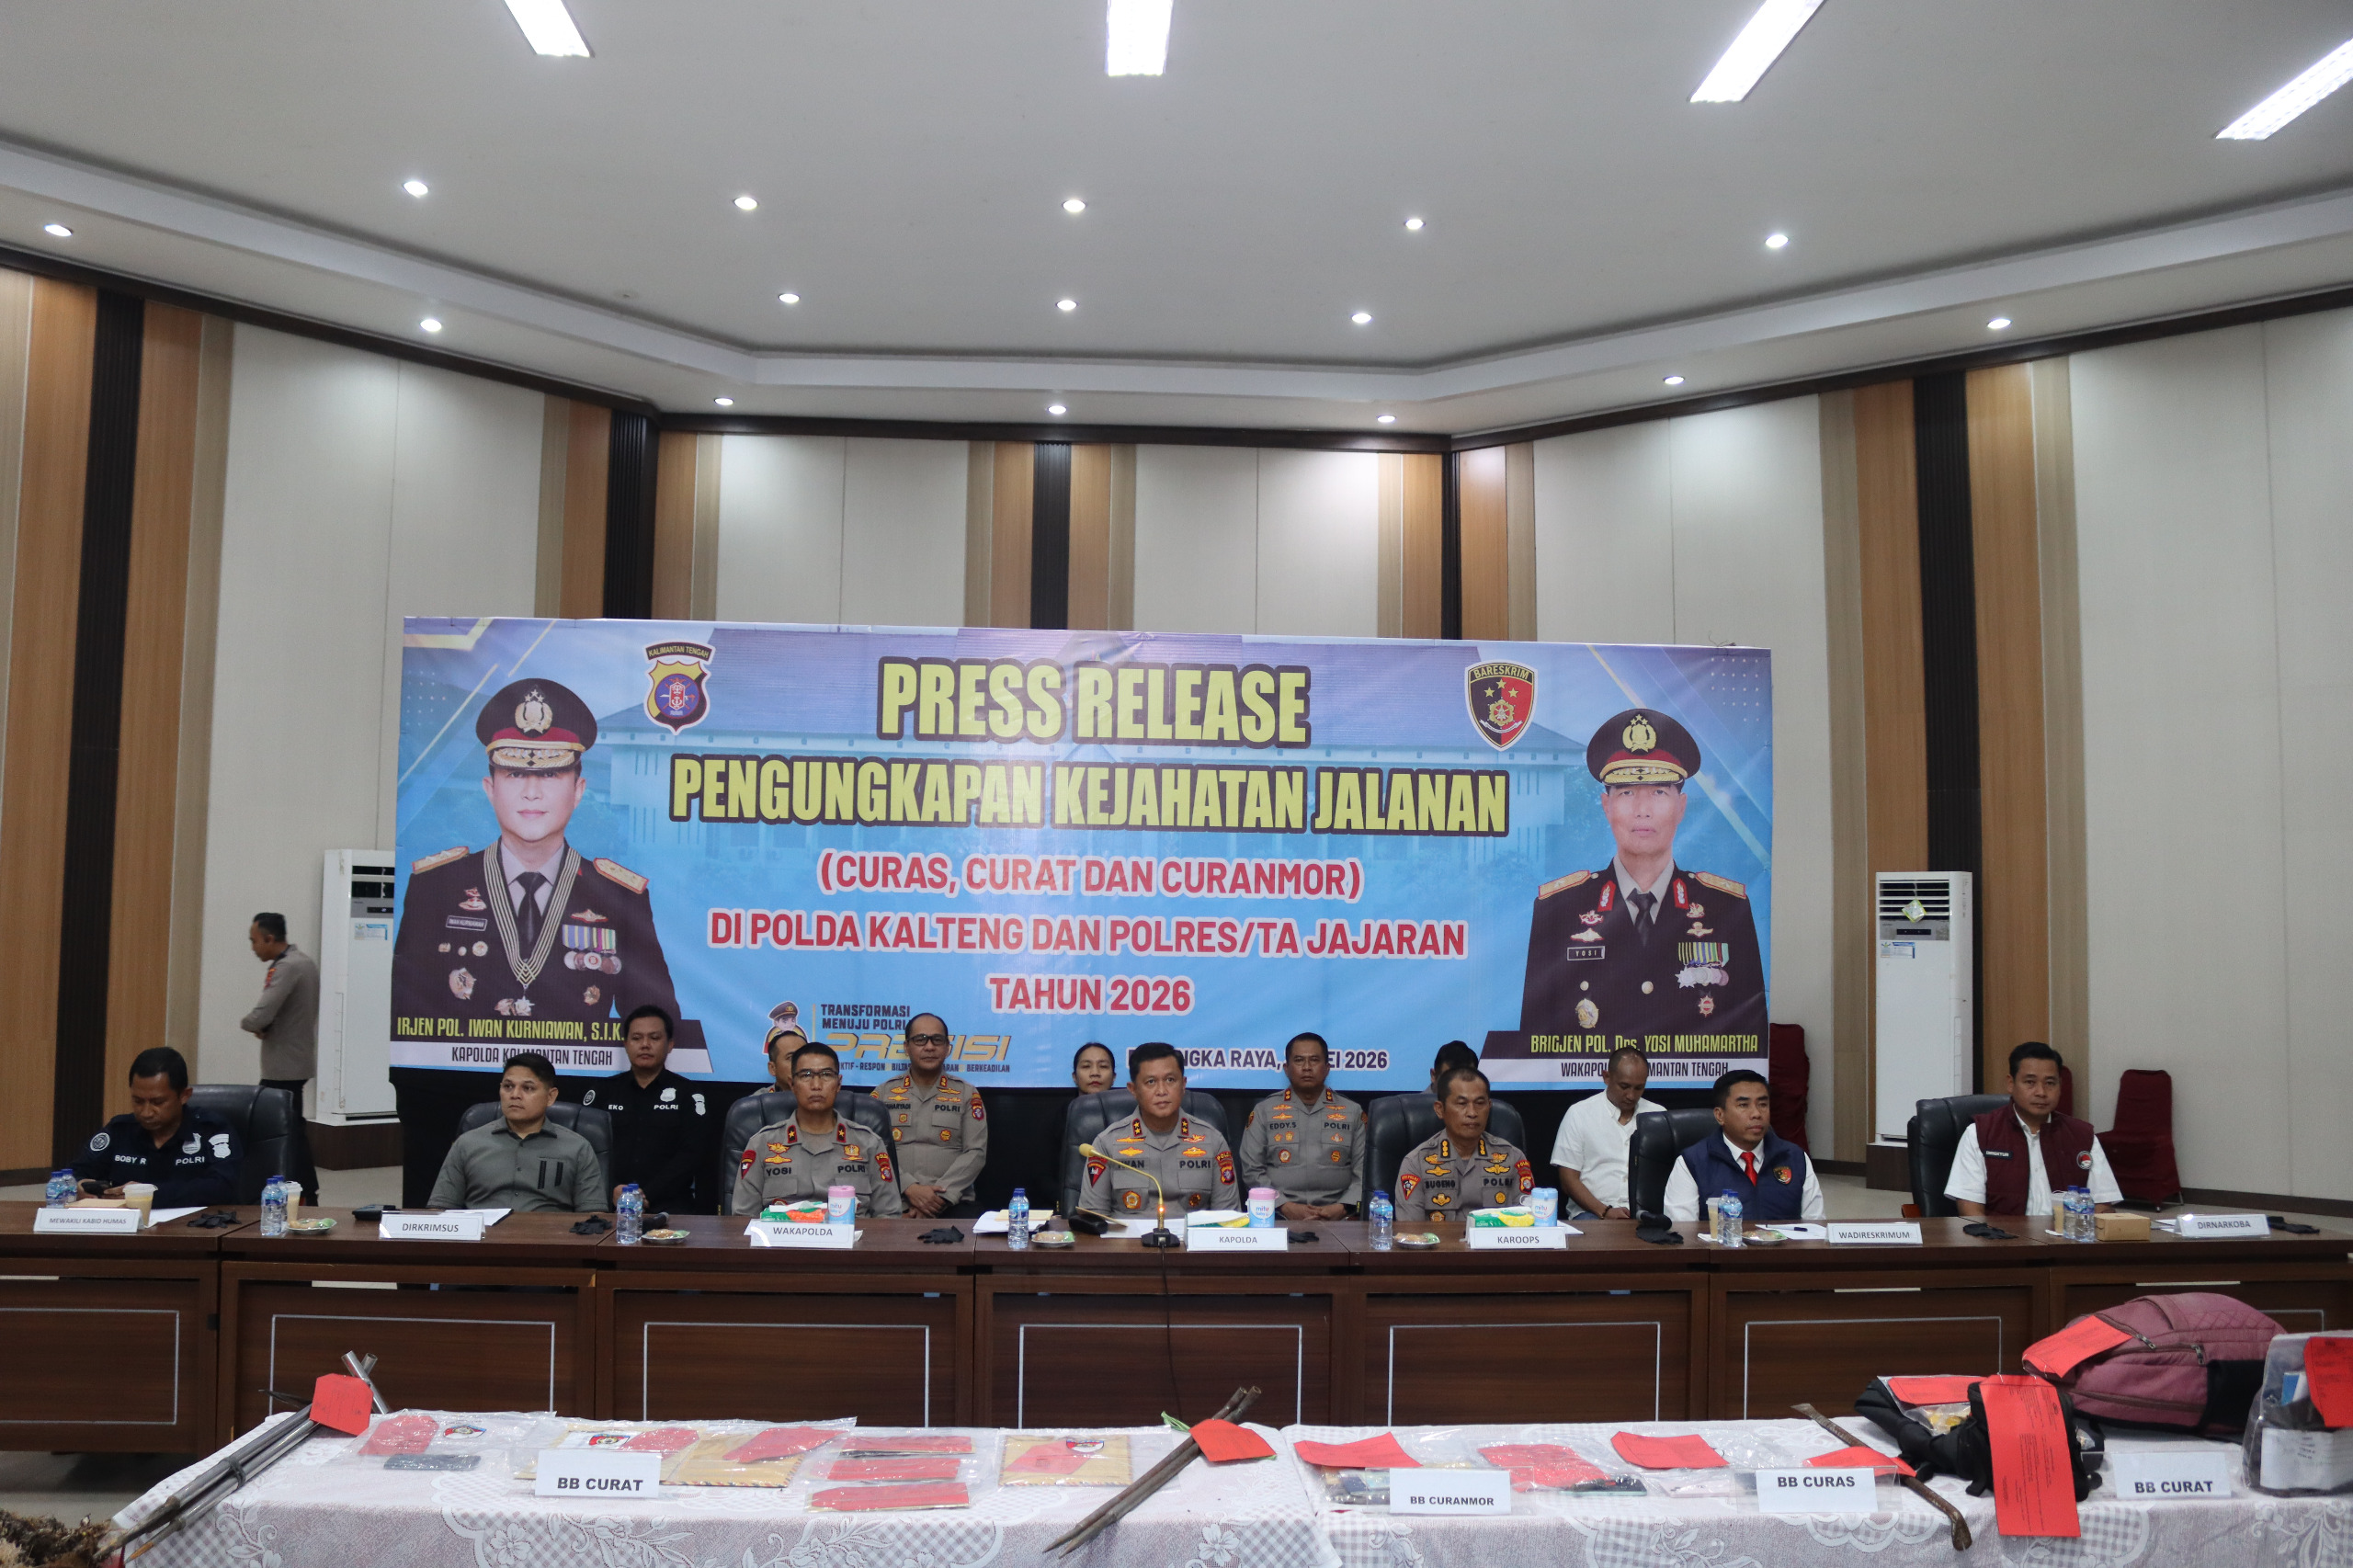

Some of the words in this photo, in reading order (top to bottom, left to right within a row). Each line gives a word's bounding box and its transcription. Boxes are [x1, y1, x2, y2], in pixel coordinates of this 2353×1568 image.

[648, 645, 685, 657] KALIMANTAN
[686, 646, 710, 659] TENGAH
[1472, 665, 1529, 680] BARESKRIM
[880, 660, 1064, 742] PRESS
[1075, 665, 1309, 746] RELEASE
[671, 756, 1043, 826] PENGUNGKAPAN
[1052, 764, 1305, 831] KEJAHATAN
[1313, 769, 1508, 835] JALANAN
[821, 851, 957, 894] (CURAS,
[965, 857, 1077, 892] CURAT
[1088, 859, 1154, 893] DAN
[1161, 860, 1360, 900] CURANMOR)
[711, 912, 741, 945] DI
[751, 913, 860, 948] POLDA
[869, 915, 1023, 950] KALTENG
[1032, 918, 1100, 952] DAN
[1109, 920, 1299, 955] POLRES/TA
[1306, 922, 1465, 956] JAJARAN
[988, 977, 1102, 1011] TAHUN
[1110, 979, 1191, 1012] 2026
[820, 1003, 911, 1018] TRANSFORMASI
[397, 1017, 434, 1037] IRJEN
[437, 1017, 464, 1038] POL.
[468, 1018, 503, 1039] IWAN
[506, 1019, 587, 1042] KURNIAWAN,
[822, 1017, 870, 1030] MENUJU
[826, 1032, 1012, 1062] PREISI
[1530, 1035, 1582, 1053] BRIGJEN
[1585, 1035, 1611, 1053] POL.
[1644, 1035, 1671, 1052] YOSI
[1674, 1035, 1758, 1053] MUHAMARTHA
[451, 1046, 499, 1063] KAPOLDA
[573, 1050, 613, 1066] TENGAH
[1231, 1050, 1281, 1070] RAYA,
[1345, 1051, 1388, 1069] 2026
[966, 1063, 1011, 1073] BERKEADILAN
[1561, 1062, 1608, 1077] WAKAPO
[1691, 1062, 1729, 1077] TENGAH
[934, 1104, 961, 1112] POLRI
[1269, 1121, 1297, 1131] EDDY.S
[1324, 1122, 1350, 1131] POLRI
[114, 1154, 138, 1164] BOBY
[139, 1157, 147, 1165] R
[175, 1155, 205, 1166] POLRI
[1179, 1159, 1211, 1169] POLRI
[766, 1166, 792, 1176] YOSI
[837, 1164, 866, 1174] POLRI
[1425, 1179, 1456, 1189] SUGENG
[1483, 1177, 1513, 1187] POLRI
[401, 1221, 460, 1233] DIRKRIMSUS
[772, 1227, 834, 1236] WAKAPOLDA
[2197, 1220, 2251, 1230] DIRNARKOBA
[1497, 1235, 1540, 1244] KAROOPS
[1838, 1231, 1911, 1239] WADIRESKRIMUM
[557, 1476, 580, 1490] BB
[584, 1477, 644, 1492] CURAT
[1777, 1475, 1800, 1488] BB
[1802, 1475, 1856, 1488] CURAS
[2134, 1481, 2157, 1494] BB
[2161, 1481, 2214, 1494] CURAT
[1409, 1495, 1427, 1506] BB
[1428, 1496, 1495, 1506] CURANMOR
